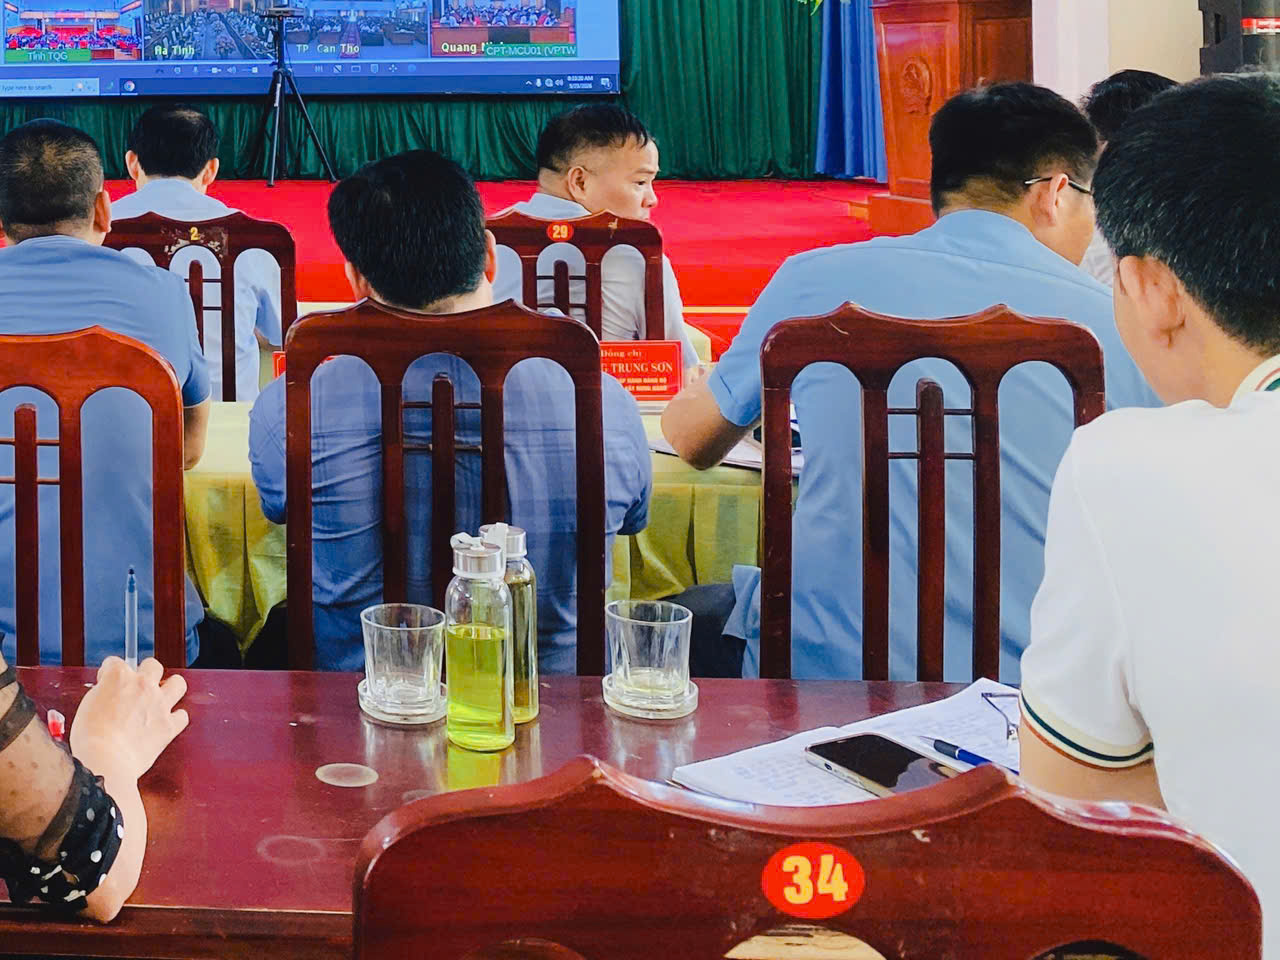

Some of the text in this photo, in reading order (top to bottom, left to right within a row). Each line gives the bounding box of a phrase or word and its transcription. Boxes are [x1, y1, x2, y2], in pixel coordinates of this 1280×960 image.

[171, 45, 195, 55] Tinh
[317, 44, 336, 53] Can
[340, 44, 360, 54] Tho
[441, 42, 477, 55] Quang
[552, 224, 568, 239] 29
[611, 362, 649, 373] TRUNG
[651, 360, 673, 373] SƠN
[782, 854, 848, 905] 34
